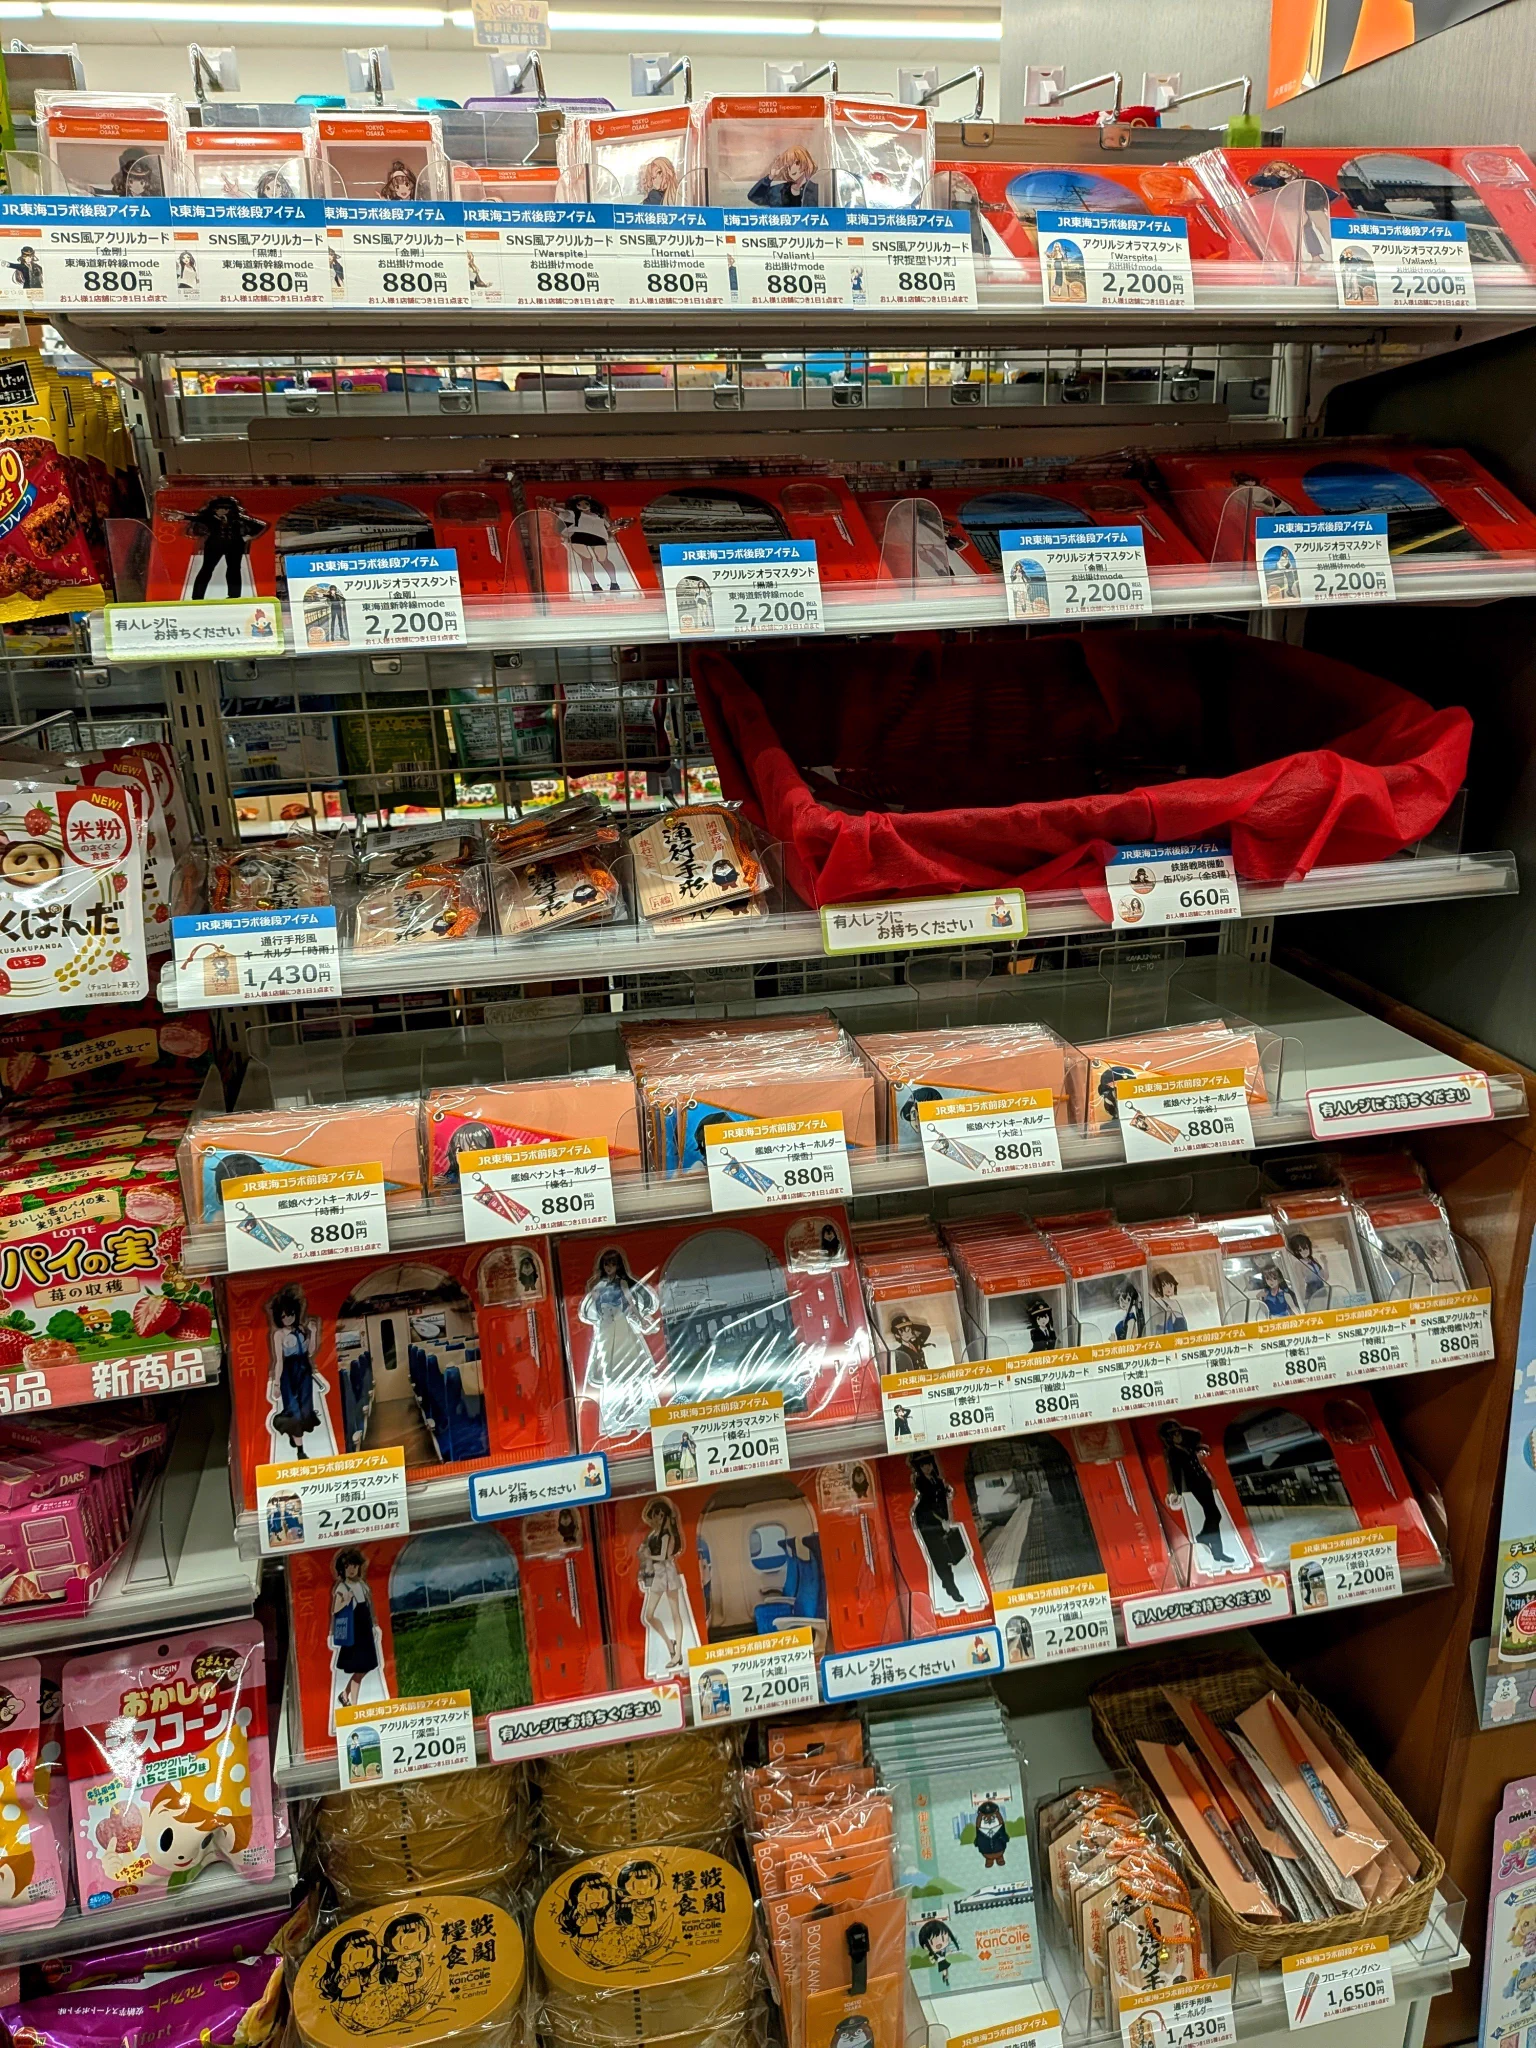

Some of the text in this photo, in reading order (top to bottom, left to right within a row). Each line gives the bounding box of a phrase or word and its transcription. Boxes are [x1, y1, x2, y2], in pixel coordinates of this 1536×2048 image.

[1058, 216, 1172, 233] JR東海コラボ後段アイテム
[1349, 224, 1452, 237] JR東海コラボ後段アイテム
[51, 232, 170, 244] SNS風アクリルカード
[208, 233, 323, 246] SNS風アクリルカード
[353, 233, 464, 246] SNS風アクリルカード
[506, 234, 613, 246] SNS風アクリルカード
[620, 234, 724, 247] SNS風アクリルカード
[742, 237, 844, 250] SNS風アクリルカード
[872, 240, 969, 253] SNS風アクリルカード
[1083, 238, 1182, 253] アクリルジオラマスタンド
[533, 248, 588, 259] 「Warspite」
[648, 249, 696, 260] 「Hornet」
[770, 252, 817, 261] 「Valiant」
[1372, 245, 1463, 256] アクリルジオラマスタンド
[65, 259, 160, 269] 東海道新幹線mode
[222, 259, 314, 270] 東海道新幹線mode
[378, 259, 444, 269] お出掛けmode
[531, 260, 594, 270] お出掛けmode
[642, 258, 705, 270] お出掛けmode
[765, 261, 825, 272] お出掛けmode
[84, 271, 152, 292] 880円
[242, 272, 308, 292] 880円
[383, 272, 447, 293] 880円
[537, 272, 600, 293] 880円
[647, 272, 708, 293] 880円
[767, 274, 826, 295] 880円
[899, 271, 956, 292] 880円
[1102, 273, 1184, 296] 2,200円
[1391, 275, 1466, 298] 2,200円
[1020, 533, 1128, 546] JR東海コラボ後段アイテム
[1294, 540, 1382, 552] アクリルジオラマスタンド
[682, 548, 800, 561] JR東海コラボ後段アイテム
[1047, 550, 1141, 563] アクリルジオラマスタンド
[310, 557, 439, 573] JR東海コラボ後段アイテム
[712, 566, 815, 581] アクリルジオラマスタンド
[344, 576, 457, 592] アクリルジオラマスタンド
[1313, 572, 1386, 595] 2,200円
[1065, 582, 1142, 606] 2,200円
[361, 600, 446, 612] 東海道新幹線mode
[734, 601, 817, 627] 2,200円
[115, 617, 178, 631] 有人レジに
[154, 626, 241, 641] お持ちください
[365, 612, 457, 640] 2,200円
[113, 763, 142, 776] NEW!
[91, 794, 122, 812] NEW!
[70, 818, 122, 842] 米粉
[80, 843, 118, 852] のさくさく
[90, 852, 110, 861] 食感
[1122, 843, 1218, 859] JR東海コラボ後段アイテム
[1171, 859, 1224, 871] 鉄路戦略機動
[1180, 889, 1230, 907] 660円
[195, 913, 318, 931] JR東海コラボ後段アイテム
[833, 911, 903, 929] 有人レジに
[877, 919, 974, 940] お持ちください
[261, 933, 317, 947] 通行手形風
[14, 956, 40, 966] いちご
[244, 964, 331, 990] 1,430円
[1133, 1075, 1230, 1094] JR東海コラボ前段アイテム
[935, 1096, 1037, 1115] JR東海コラボ前段アイテム
[1164, 1091, 1243, 1108] 艦娘ペナントキーホルダー
[1319, 1087, 1470, 1118] 有人レジにお持ちください
[722, 1119, 828, 1139] JR東海コラボ前段アイテム
[967, 1114, 1050, 1132] 艦娘ペナントキーホルダー
[1188, 1118, 1234, 1137] 880円
[478, 1144, 591, 1166] JR東海コラボ前段アイテム
[755, 1138, 842, 1155] 艦娘ペナントキーホルダー
[995, 1142, 1042, 1161] 880円
[243, 1170, 365, 1193] JR東海コラボ前段アイテム
[511, 1164, 604, 1183] 艦娘ペナントキーホルダー
[784, 1167, 834, 1186] 880円
[278, 1190, 379, 1210] 艦娘ペナントキーホルダー
[542, 1195, 594, 1215] 880円
[52, 1225, 97, 1238] LOTTE
[310, 1222, 367, 1243] 880円
[3, 1228, 158, 1287] パイの実
[49, 1280, 124, 1302] 苺の収穫
[1440, 1333, 1479, 1353] 880円
[1359, 1345, 1399, 1365] 880円
[92, 1348, 206, 1400] 新商品
[1285, 1355, 1327, 1376] 880円
[1206, 1368, 1249, 1388] 880円
[1120, 1380, 1164, 1402] 880円
[668, 1397, 769, 1421] JR東海コラボ前段アイテム
[1035, 1393, 1080, 1414] 880円
[691, 1412, 780, 1435] アクリルジオラマスタンド
[949, 1406, 995, 1428] 880円
[142, 1433, 162, 1448] DARS
[707, 1438, 780, 1467] 2,200円
[276, 1455, 388, 1480] JR東海コラボ前段アイテム
[60, 1472, 85, 1487] DARS
[301, 1473, 400, 1496] アクリルジオラマスタンド
[478, 1481, 527, 1498] 有人レジに
[509, 1482, 577, 1503] お持ちください
[318, 1503, 399, 1530] 2,200円
[1336, 1566, 1394, 1591] 2,200円
[1512, 1572, 1520, 1584] 3
[1132, 1588, 1272, 1626] 有人レジにお持ちください
[1045, 1619, 1109, 1648] 2,200円
[152, 1664, 178, 1676] NISSIN
[196, 1656, 232, 1666] つまんで
[831, 1656, 893, 1680] 有人レジに
[870, 1659, 956, 1685] お持ちください
[123, 1681, 217, 1716] おかしの
[741, 1676, 810, 1704] 2,200円
[379, 1710, 470, 1733] アクリルジオラマスタンド
[499, 1699, 662, 1742] 有人レジにお持ちください
[392, 1736, 466, 1766] 2,200円
[146, 1754, 196, 1771] サクサクハート
[136, 1762, 207, 1788] いちごミルク味
[98, 1792, 118, 1805] チョコ
[115, 1858, 152, 1879] いちご味の
[672, 1870, 700, 1916] 糧食
[700, 1866, 726, 1914] 戦闘
[440, 1919, 468, 1970] 糧食
[470, 1914, 496, 1964] 戦闘
[976, 1931, 1030, 1950] KanColle
[1116, 1936, 1128, 1976] 旅行安全
[449, 1972, 490, 1986] KanColle
[1322, 1963, 1381, 1982] フローティングペン
[1327, 1981, 1384, 2008] 1,650円
[1166, 2018, 1226, 2045] 1,430円
